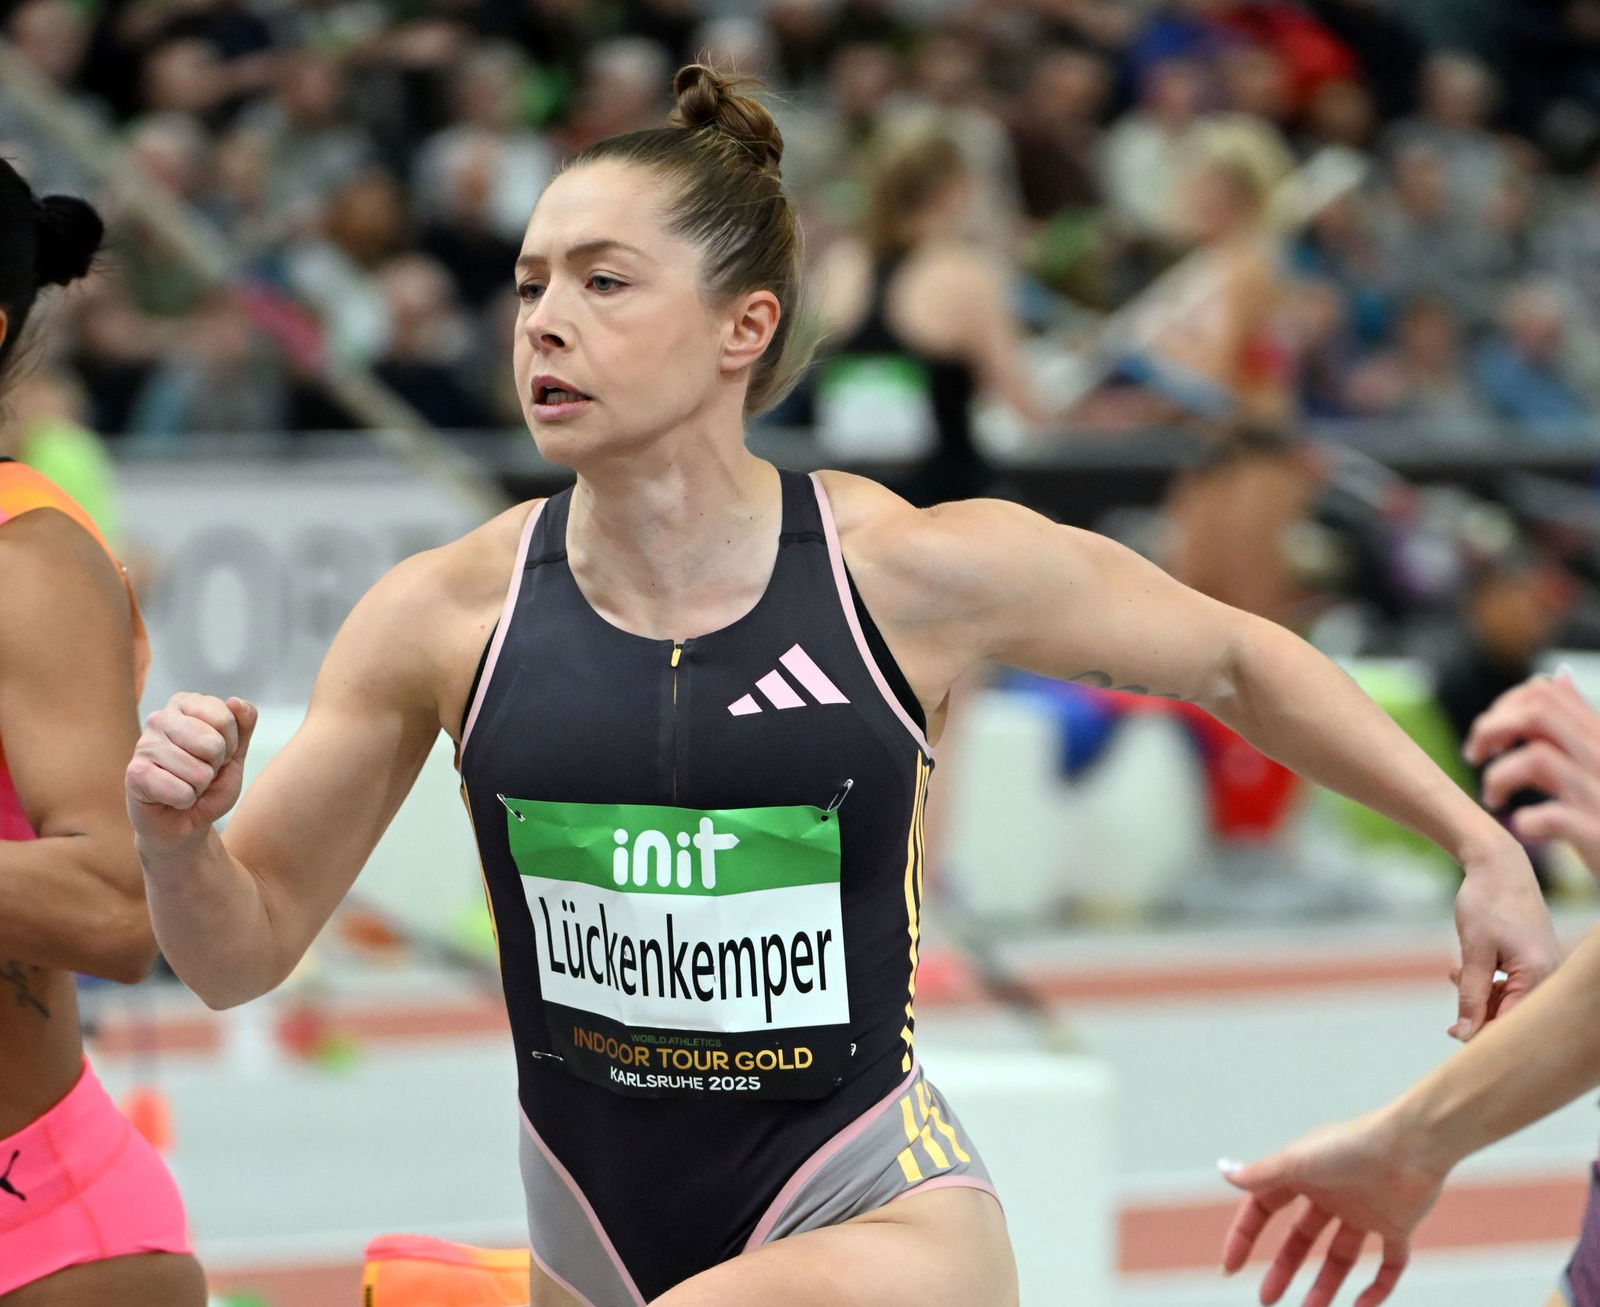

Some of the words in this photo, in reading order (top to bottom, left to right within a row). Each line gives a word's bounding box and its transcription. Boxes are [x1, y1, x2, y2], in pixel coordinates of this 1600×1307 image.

[613, 816, 741, 889] init
[538, 896, 832, 1023] Lückenkemper
[573, 1026, 651, 1067] INDOOR
[661, 1047, 730, 1070] TOUR
[735, 1047, 813, 1070] GOLD
[630, 1033, 666, 1046] WORLD
[667, 1036, 722, 1048] ATHLETICS
[610, 1066, 704, 1091] KARLSRUHE
[709, 1075, 761, 1091] 2025
